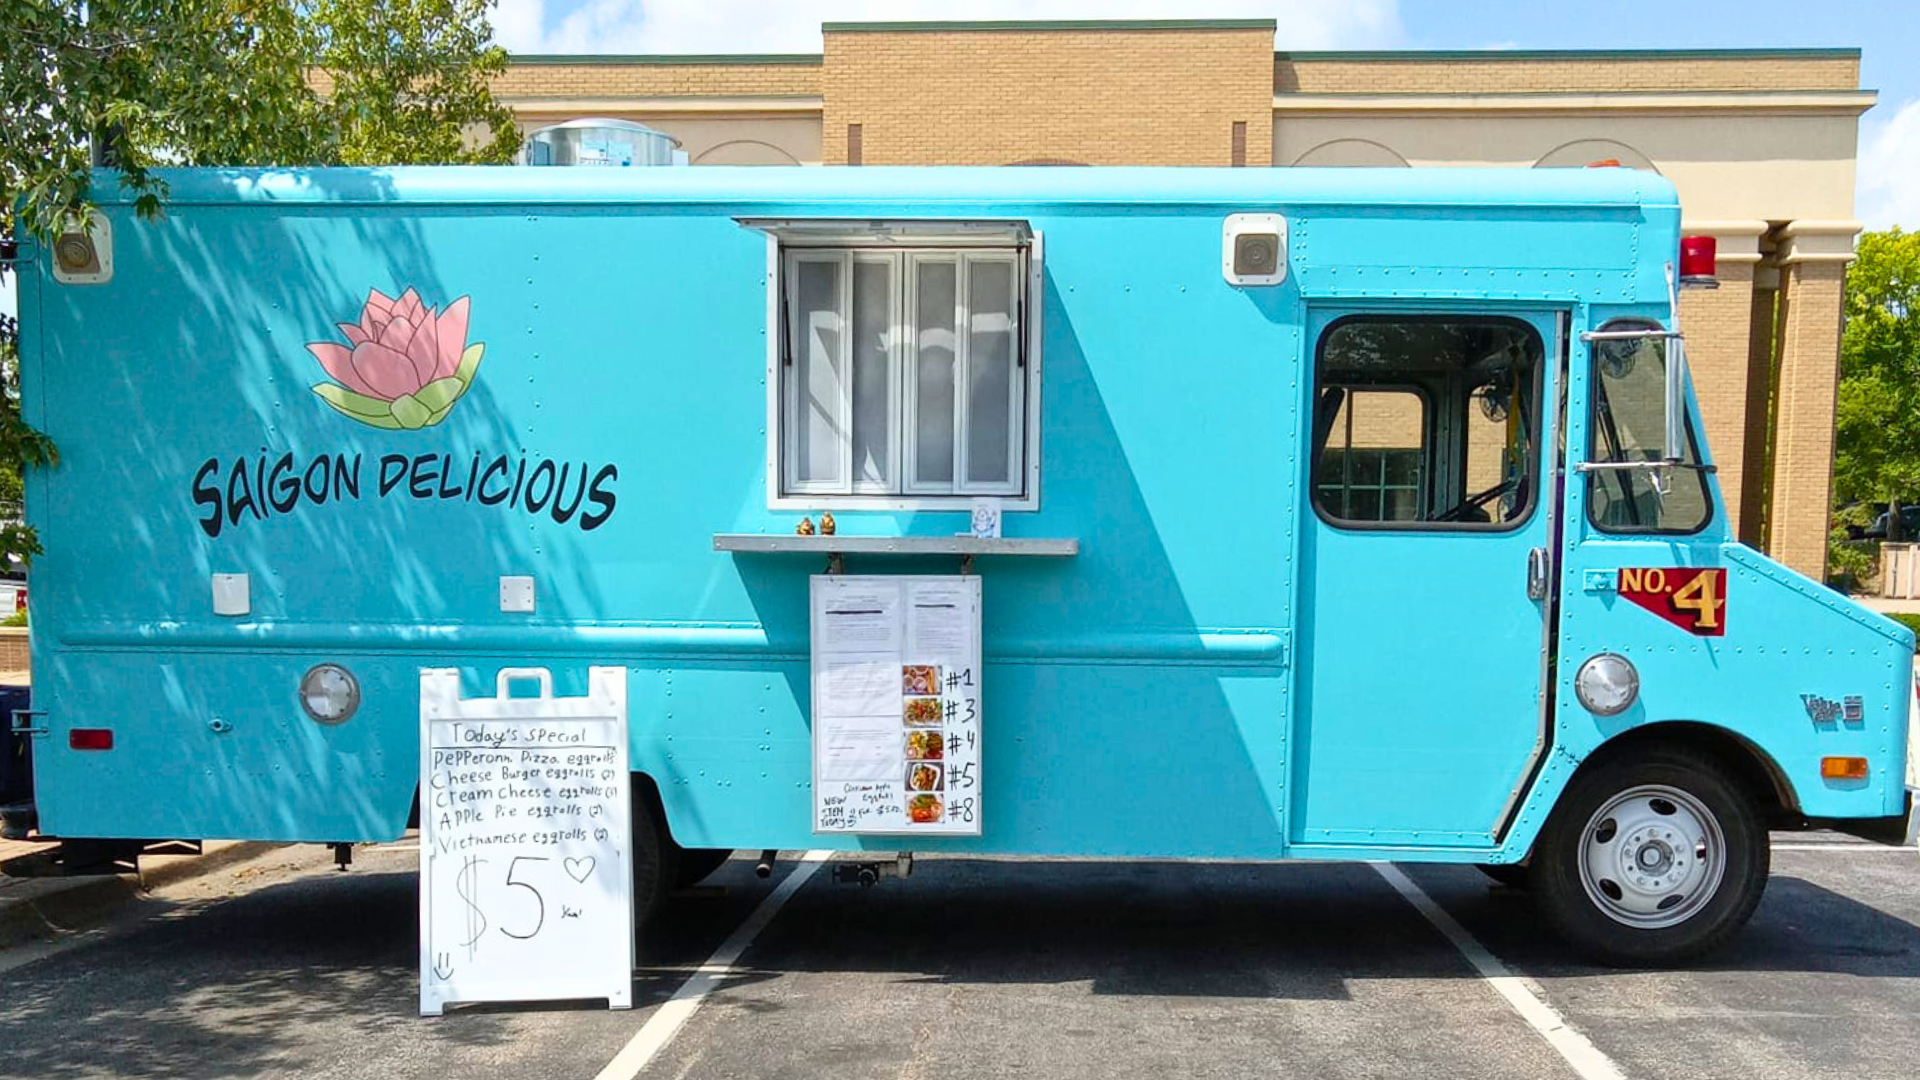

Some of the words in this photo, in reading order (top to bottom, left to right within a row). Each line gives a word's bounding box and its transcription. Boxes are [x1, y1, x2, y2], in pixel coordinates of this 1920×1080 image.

[1621, 568, 1672, 593] NO.
[1672, 569, 1725, 628] 4
[946, 668, 975, 692] #1
[945, 698, 976, 724] #3
[452, 723, 518, 749] Today's
[947, 729, 976, 756] #4
[431, 770, 493, 789] Cheese
[502, 766, 542, 781] Burger
[947, 762, 976, 791] #5
[436, 788, 494, 808] Cream
[824, 796, 847, 805] NEW
[948, 797, 975, 823] #8
[440, 808, 484, 831] Apple
[438, 833, 527, 855] Vietnamese
